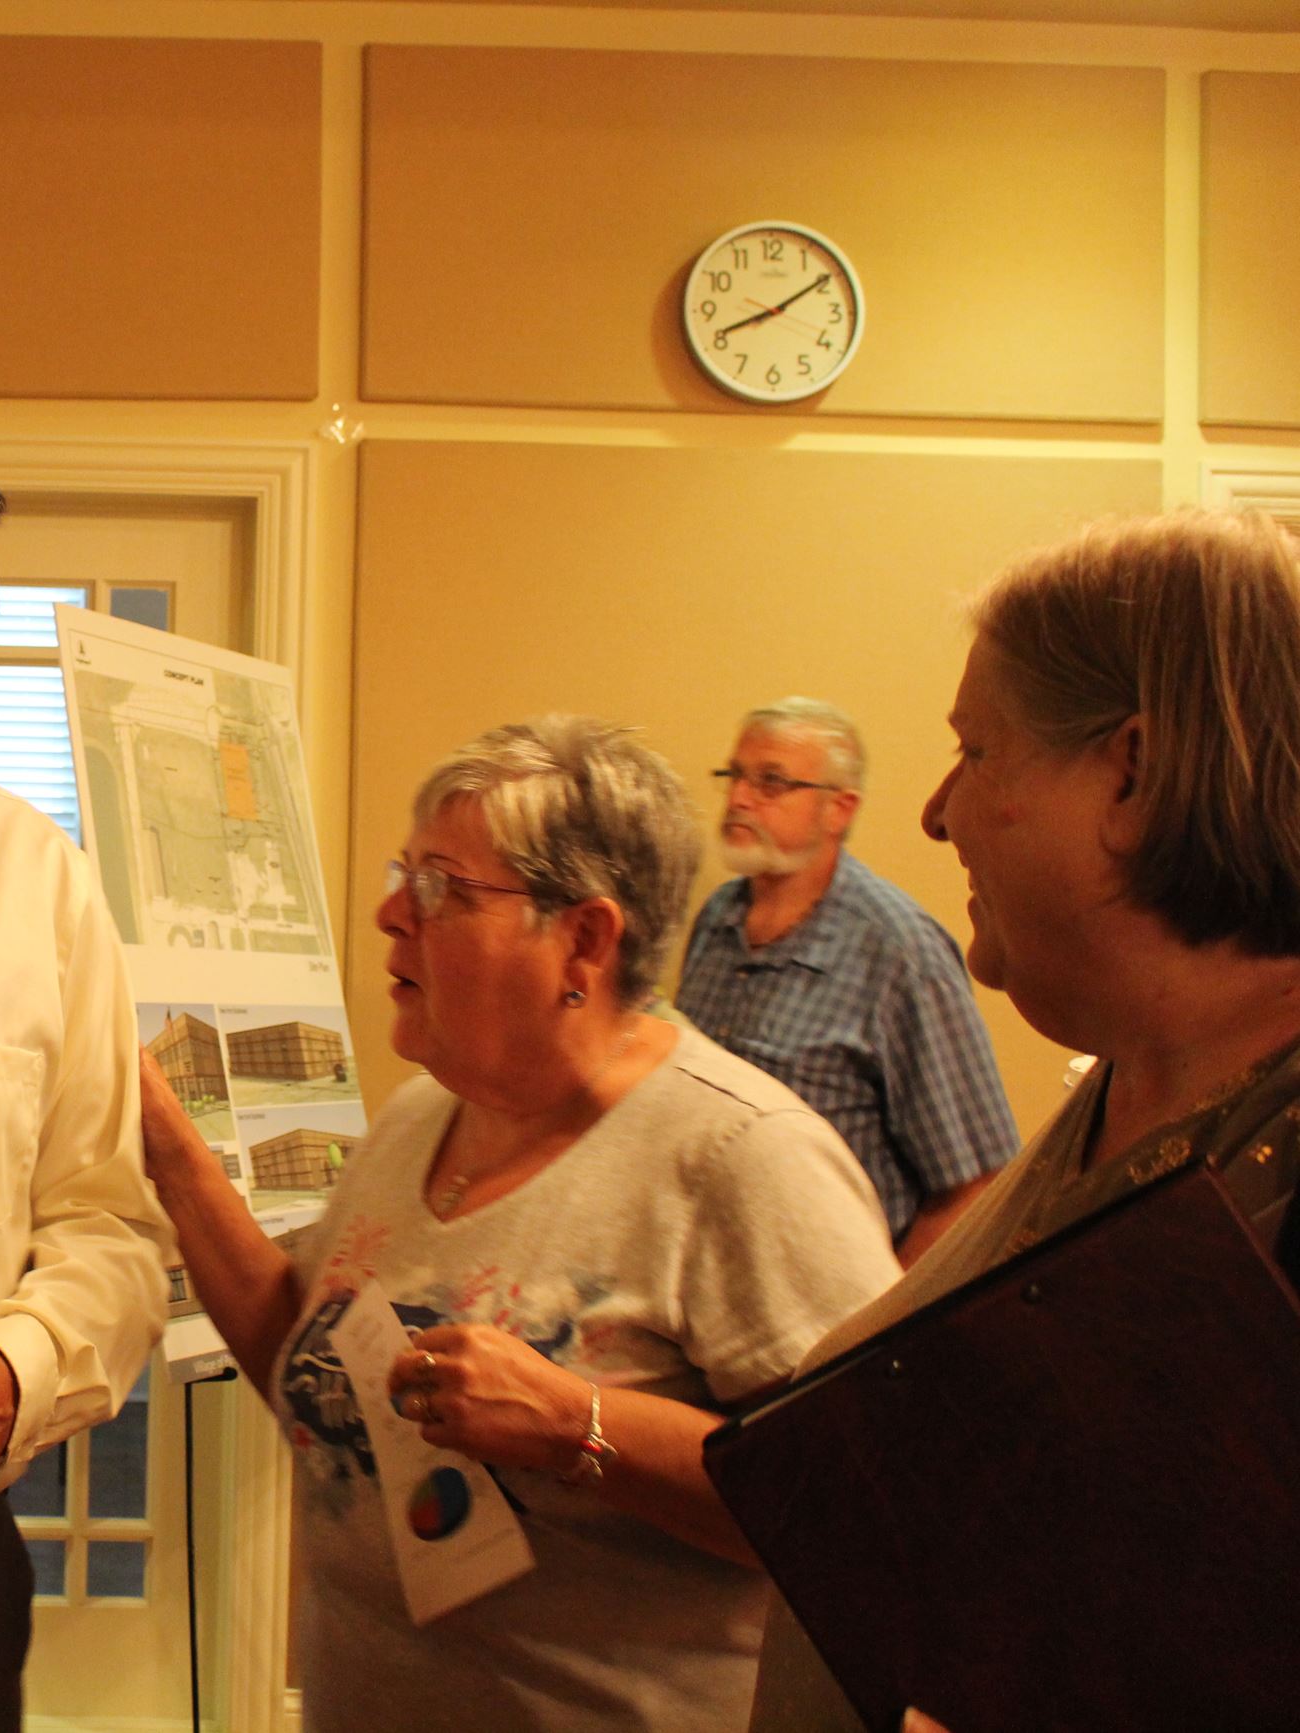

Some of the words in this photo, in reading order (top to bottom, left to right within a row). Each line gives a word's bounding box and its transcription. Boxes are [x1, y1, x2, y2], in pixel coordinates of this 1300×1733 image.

[733, 248, 748, 270] 11
[761, 239, 784, 261] 12
[799, 248, 807, 271] 1
[709, 270, 732, 292] 10
[815, 273, 831, 294] 2
[700, 300, 717, 322] 9
[828, 302, 843, 324] 3
[713, 328, 728, 350] 8
[816, 329, 832, 351] 4
[734, 353, 748, 374] 7
[765, 363, 782, 385] 6
[797, 354, 812, 375] 5
